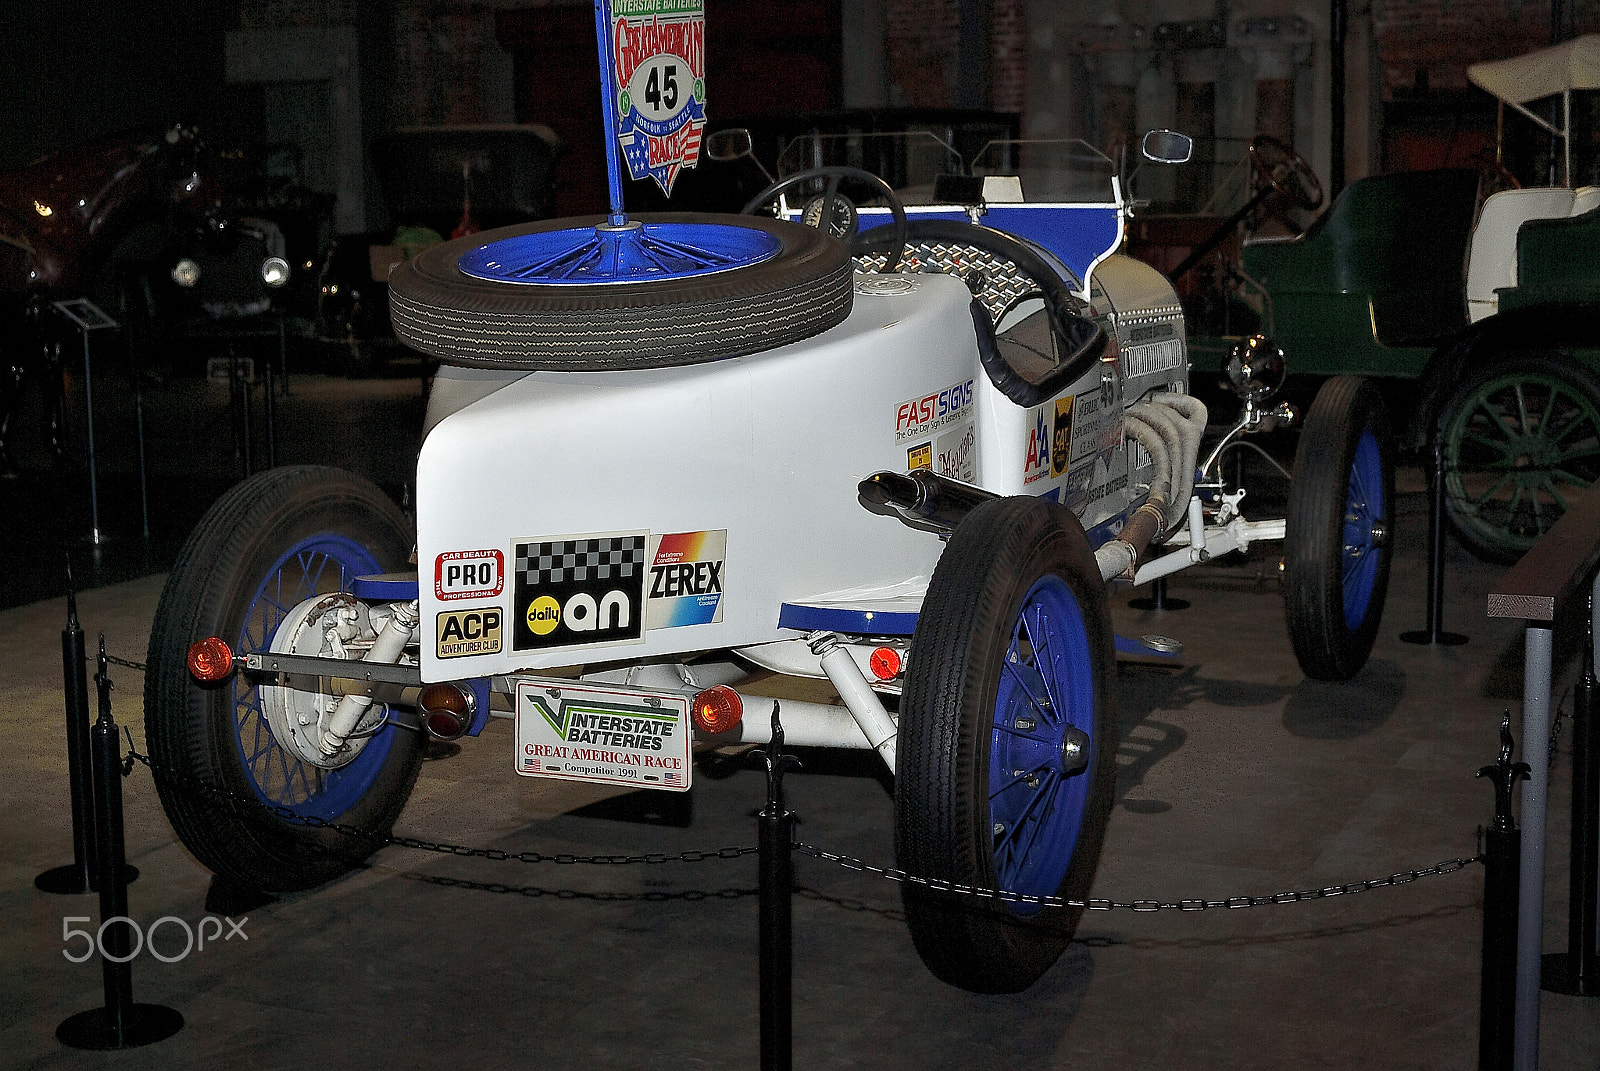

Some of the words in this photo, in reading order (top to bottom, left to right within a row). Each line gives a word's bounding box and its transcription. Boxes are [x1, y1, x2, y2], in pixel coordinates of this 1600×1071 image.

[614, 0, 661, 13] INTERSTATE
[645, 65, 679, 111] 45
[668, 104, 691, 131] SEATTLE
[648, 131, 680, 166] RACE
[895, 432, 906, 440] The
[907, 427, 918, 437] One
[919, 424, 930, 433] Day
[441, 552, 461, 560] CAR
[462, 550, 498, 559] BEAUTY
[447, 562, 491, 587] PRO
[649, 560, 723, 599] ZEREX
[443, 590, 496, 600] PROFESSIONAL
[528, 606, 559, 623] daily
[440, 612, 500, 642] ACP
[440, 641, 482, 655] ADVENTURER
[482, 640, 499, 650] CLUB
[570, 713, 675, 737] INTERSTATE
[567, 728, 663, 751] BATTERIES
[524, 743, 570, 758] GREAT
[571, 747, 641, 767] AMERICAN
[643, 755, 682, 770] RACE
[564, 762, 615, 776] Competitor
[617, 767, 638, 779] 1991
